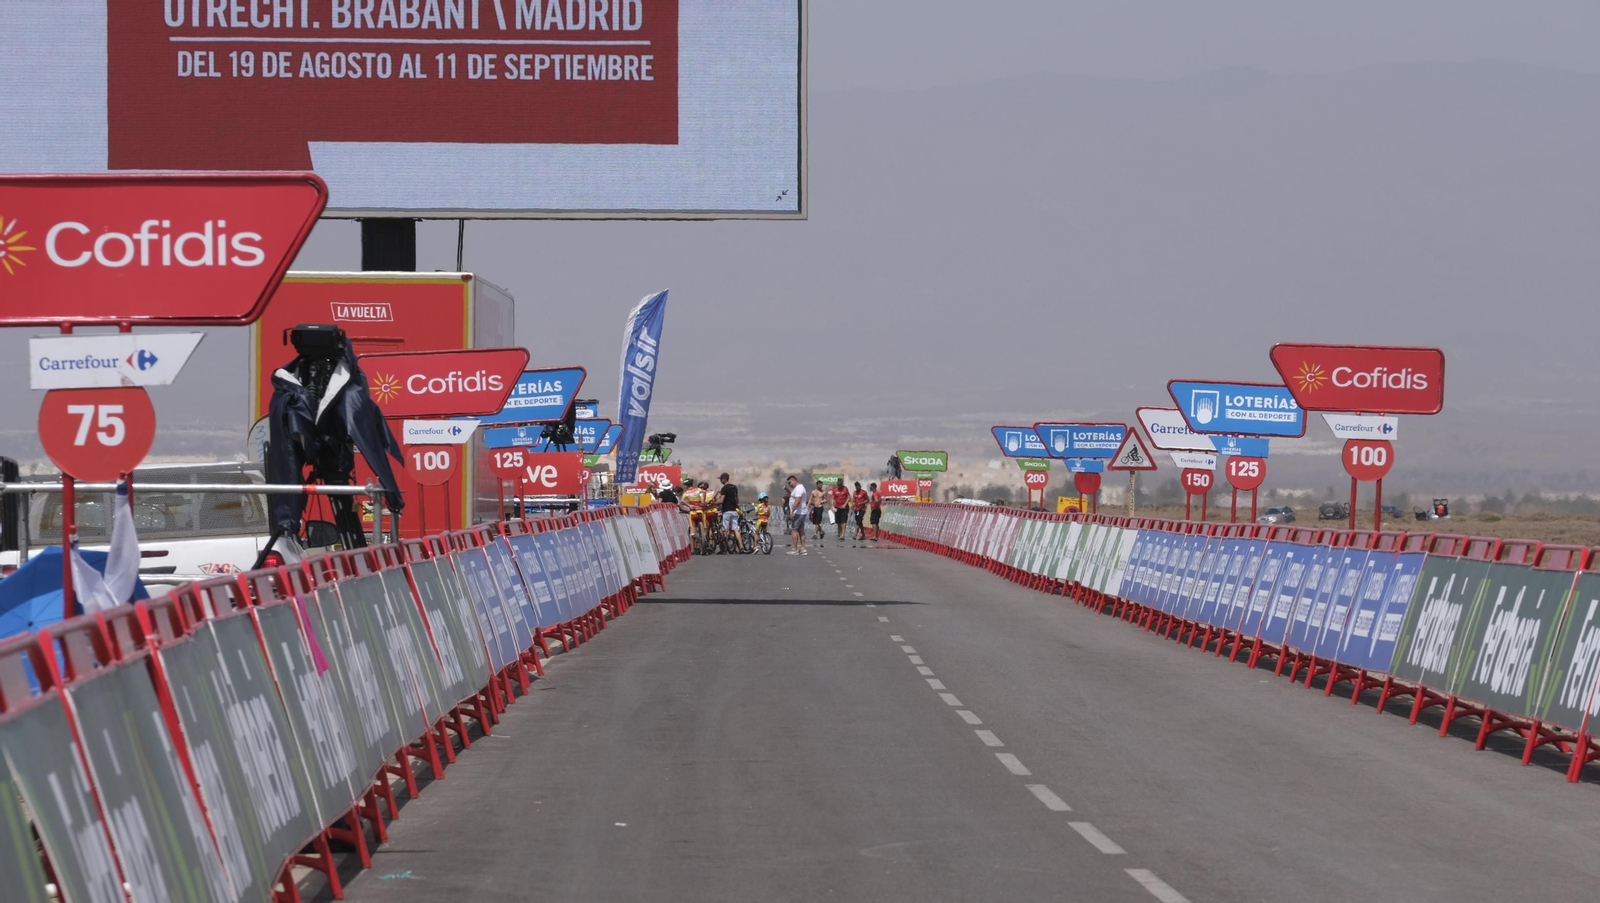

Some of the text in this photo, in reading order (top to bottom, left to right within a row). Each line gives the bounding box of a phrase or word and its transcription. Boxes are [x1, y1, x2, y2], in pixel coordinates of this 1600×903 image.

[515, 0, 643, 32] MADRID
[177, 50, 655, 81] DEL 19 DE AGOSTO AL 11 DE SEPTIEMBRE
[45, 219, 266, 268] Cofidis
[337, 306, 387, 318] LA VUELTA
[39, 356, 119, 371] Carrefour
[406, 370, 504, 395] Cofidis
[1331, 366, 1428, 390] Cofidis
[524, 397, 558, 405] DEPORTE
[1225, 394, 1298, 410] LOTERÍAS
[67, 404, 126, 446] 75
[408, 427, 445, 435] Carrefour
[1335, 424, 1374, 432] Carrefour
[1073, 431, 1122, 441] LOTERÍAS
[412, 451, 450, 471] 100
[494, 452, 524, 469] 125
[1351, 445, 1387, 466] 100
[1229, 461, 1260, 477] 125
[1026, 473, 1046, 483] 200
[1186, 472, 1210, 487] 150
[888, 482, 908, 493] rtve
